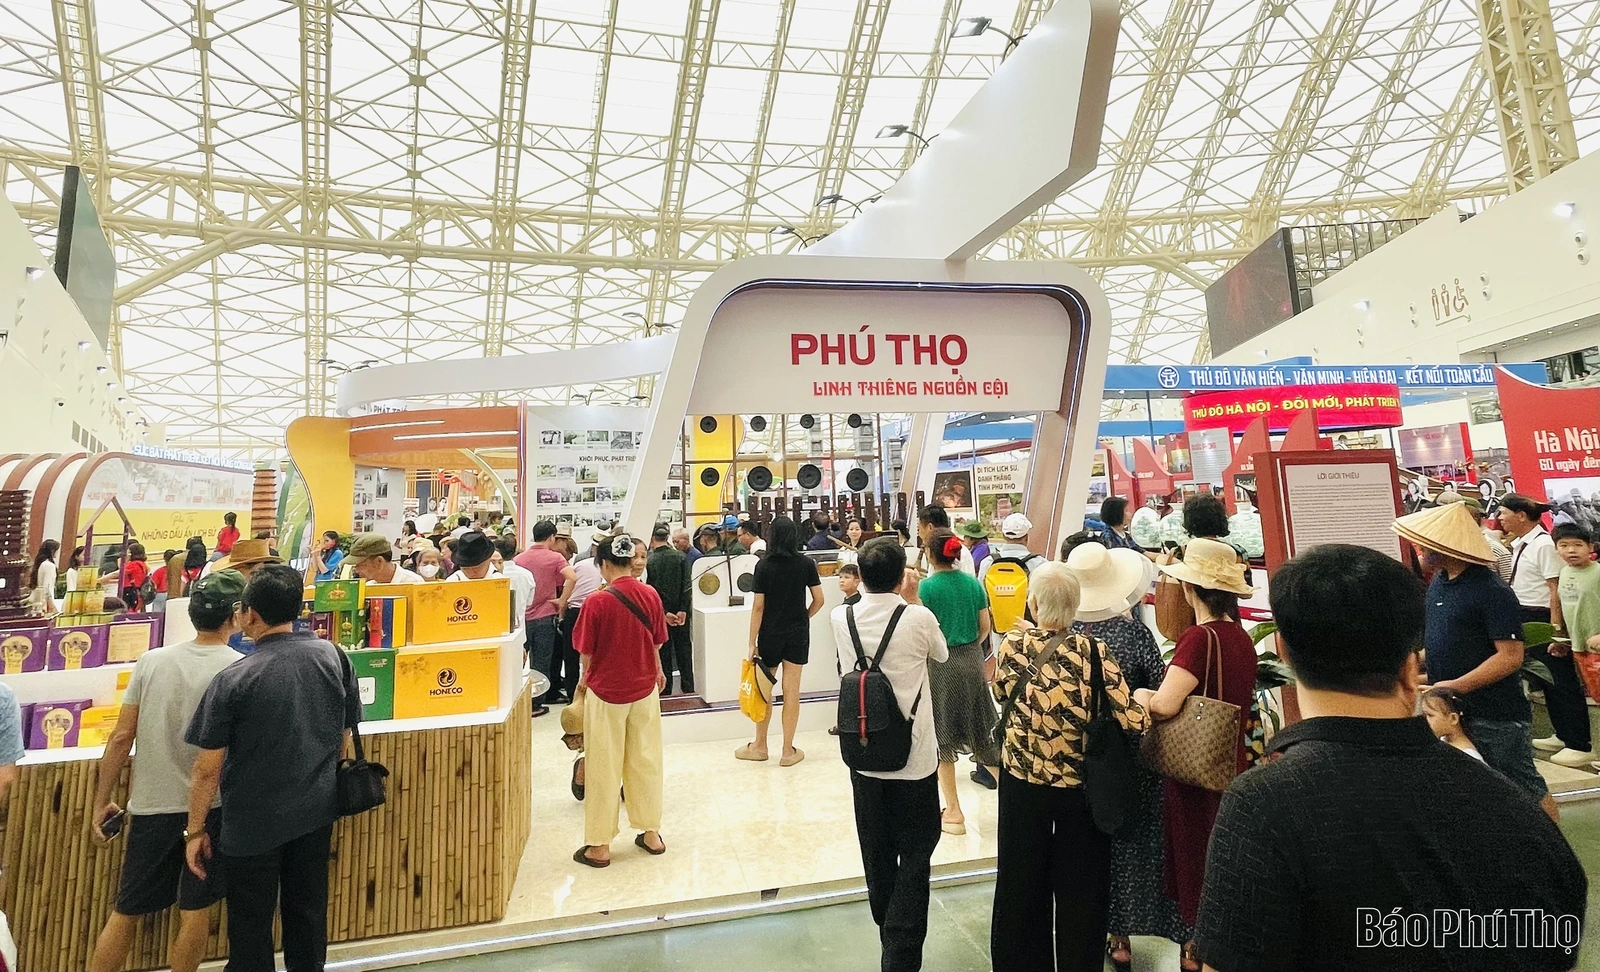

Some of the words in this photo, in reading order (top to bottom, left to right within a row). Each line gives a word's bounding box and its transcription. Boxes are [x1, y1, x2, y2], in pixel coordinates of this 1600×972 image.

[791, 325, 875, 365] PHÚ
[886, 334, 967, 374] THỌ
[1189, 367, 1212, 385] THỦ
[1215, 367, 1231, 385] ĐÔ
[1233, 368, 1256, 385] VĂN
[1258, 365, 1284, 385] HIẾN
[1293, 368, 1316, 385] VĂN
[1317, 370, 1344, 384] MINH
[1405, 365, 1423, 383] KẾT
[1426, 365, 1444, 383] NỐI
[1444, 367, 1472, 383] TOÀN
[1472, 364, 1493, 383] CẦU
[813, 382, 851, 396] LINH
[858, 378, 917, 396] THIÊNG
[924, 374, 977, 396] NGUỒN
[983, 378, 1009, 399] CỘI
[1192, 405, 1207, 418] THỦ
[1209, 403, 1223, 416] ĐÔ
[1226, 401, 1243, 414] HÀ
[1247, 400, 1271, 414] NỘI
[1282, 395, 1309, 410] ĐỔI
[1312, 395, 1343, 409] MỚI,
[1346, 394, 1375, 407] PHÁT
[1534, 430, 1561, 453] Hà
[1564, 427, 1600, 454] Nội
[1539, 458, 1554, 470] 60
[1556, 458, 1580, 472] ngày
[141, 528, 167, 540] NHỮNG
[446, 614, 478, 622] HONECO
[429, 687, 463, 696] HONECO
